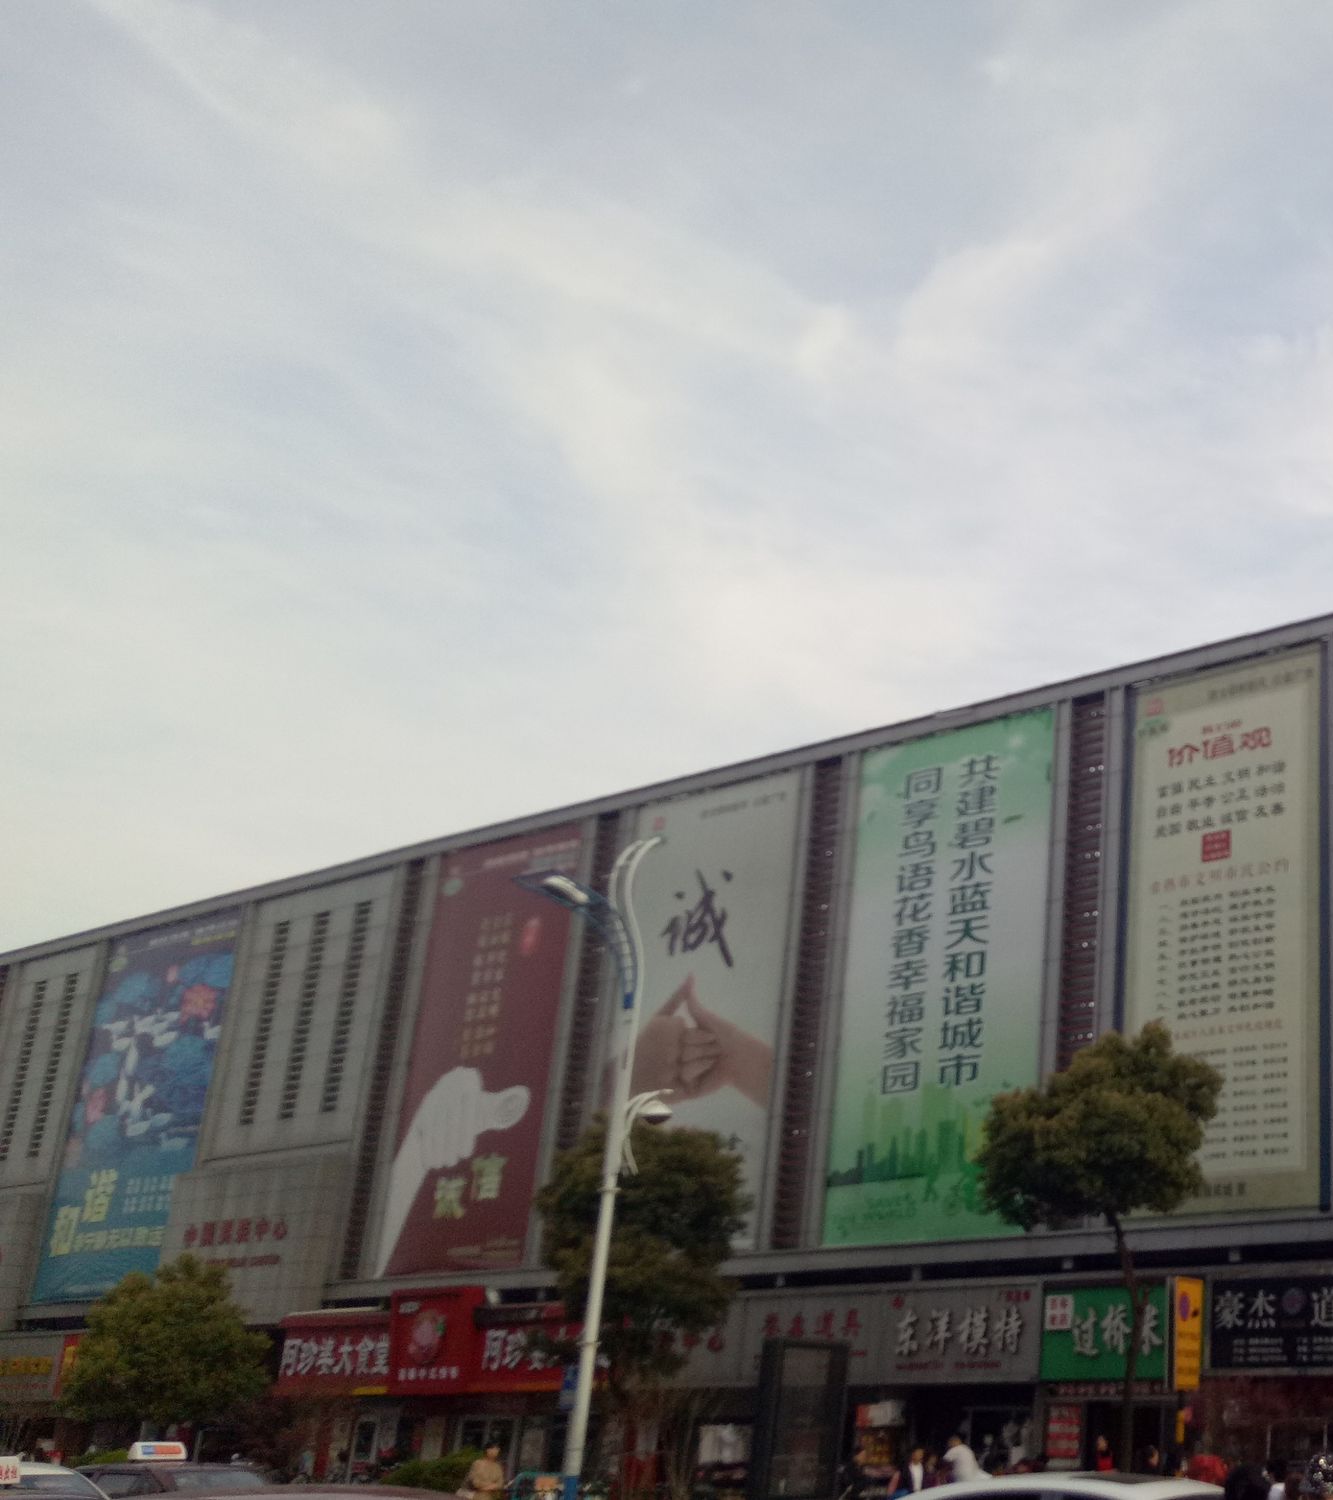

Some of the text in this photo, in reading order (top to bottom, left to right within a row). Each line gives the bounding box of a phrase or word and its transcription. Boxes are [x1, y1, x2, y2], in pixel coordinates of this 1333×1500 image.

[880, 766, 944, 1097] 同享鸟语花香幸福家园
[937, 754, 1000, 1090] 共建碧水蓝天和谐城市
[896, 1304, 1024, 1357] 东洋模特
